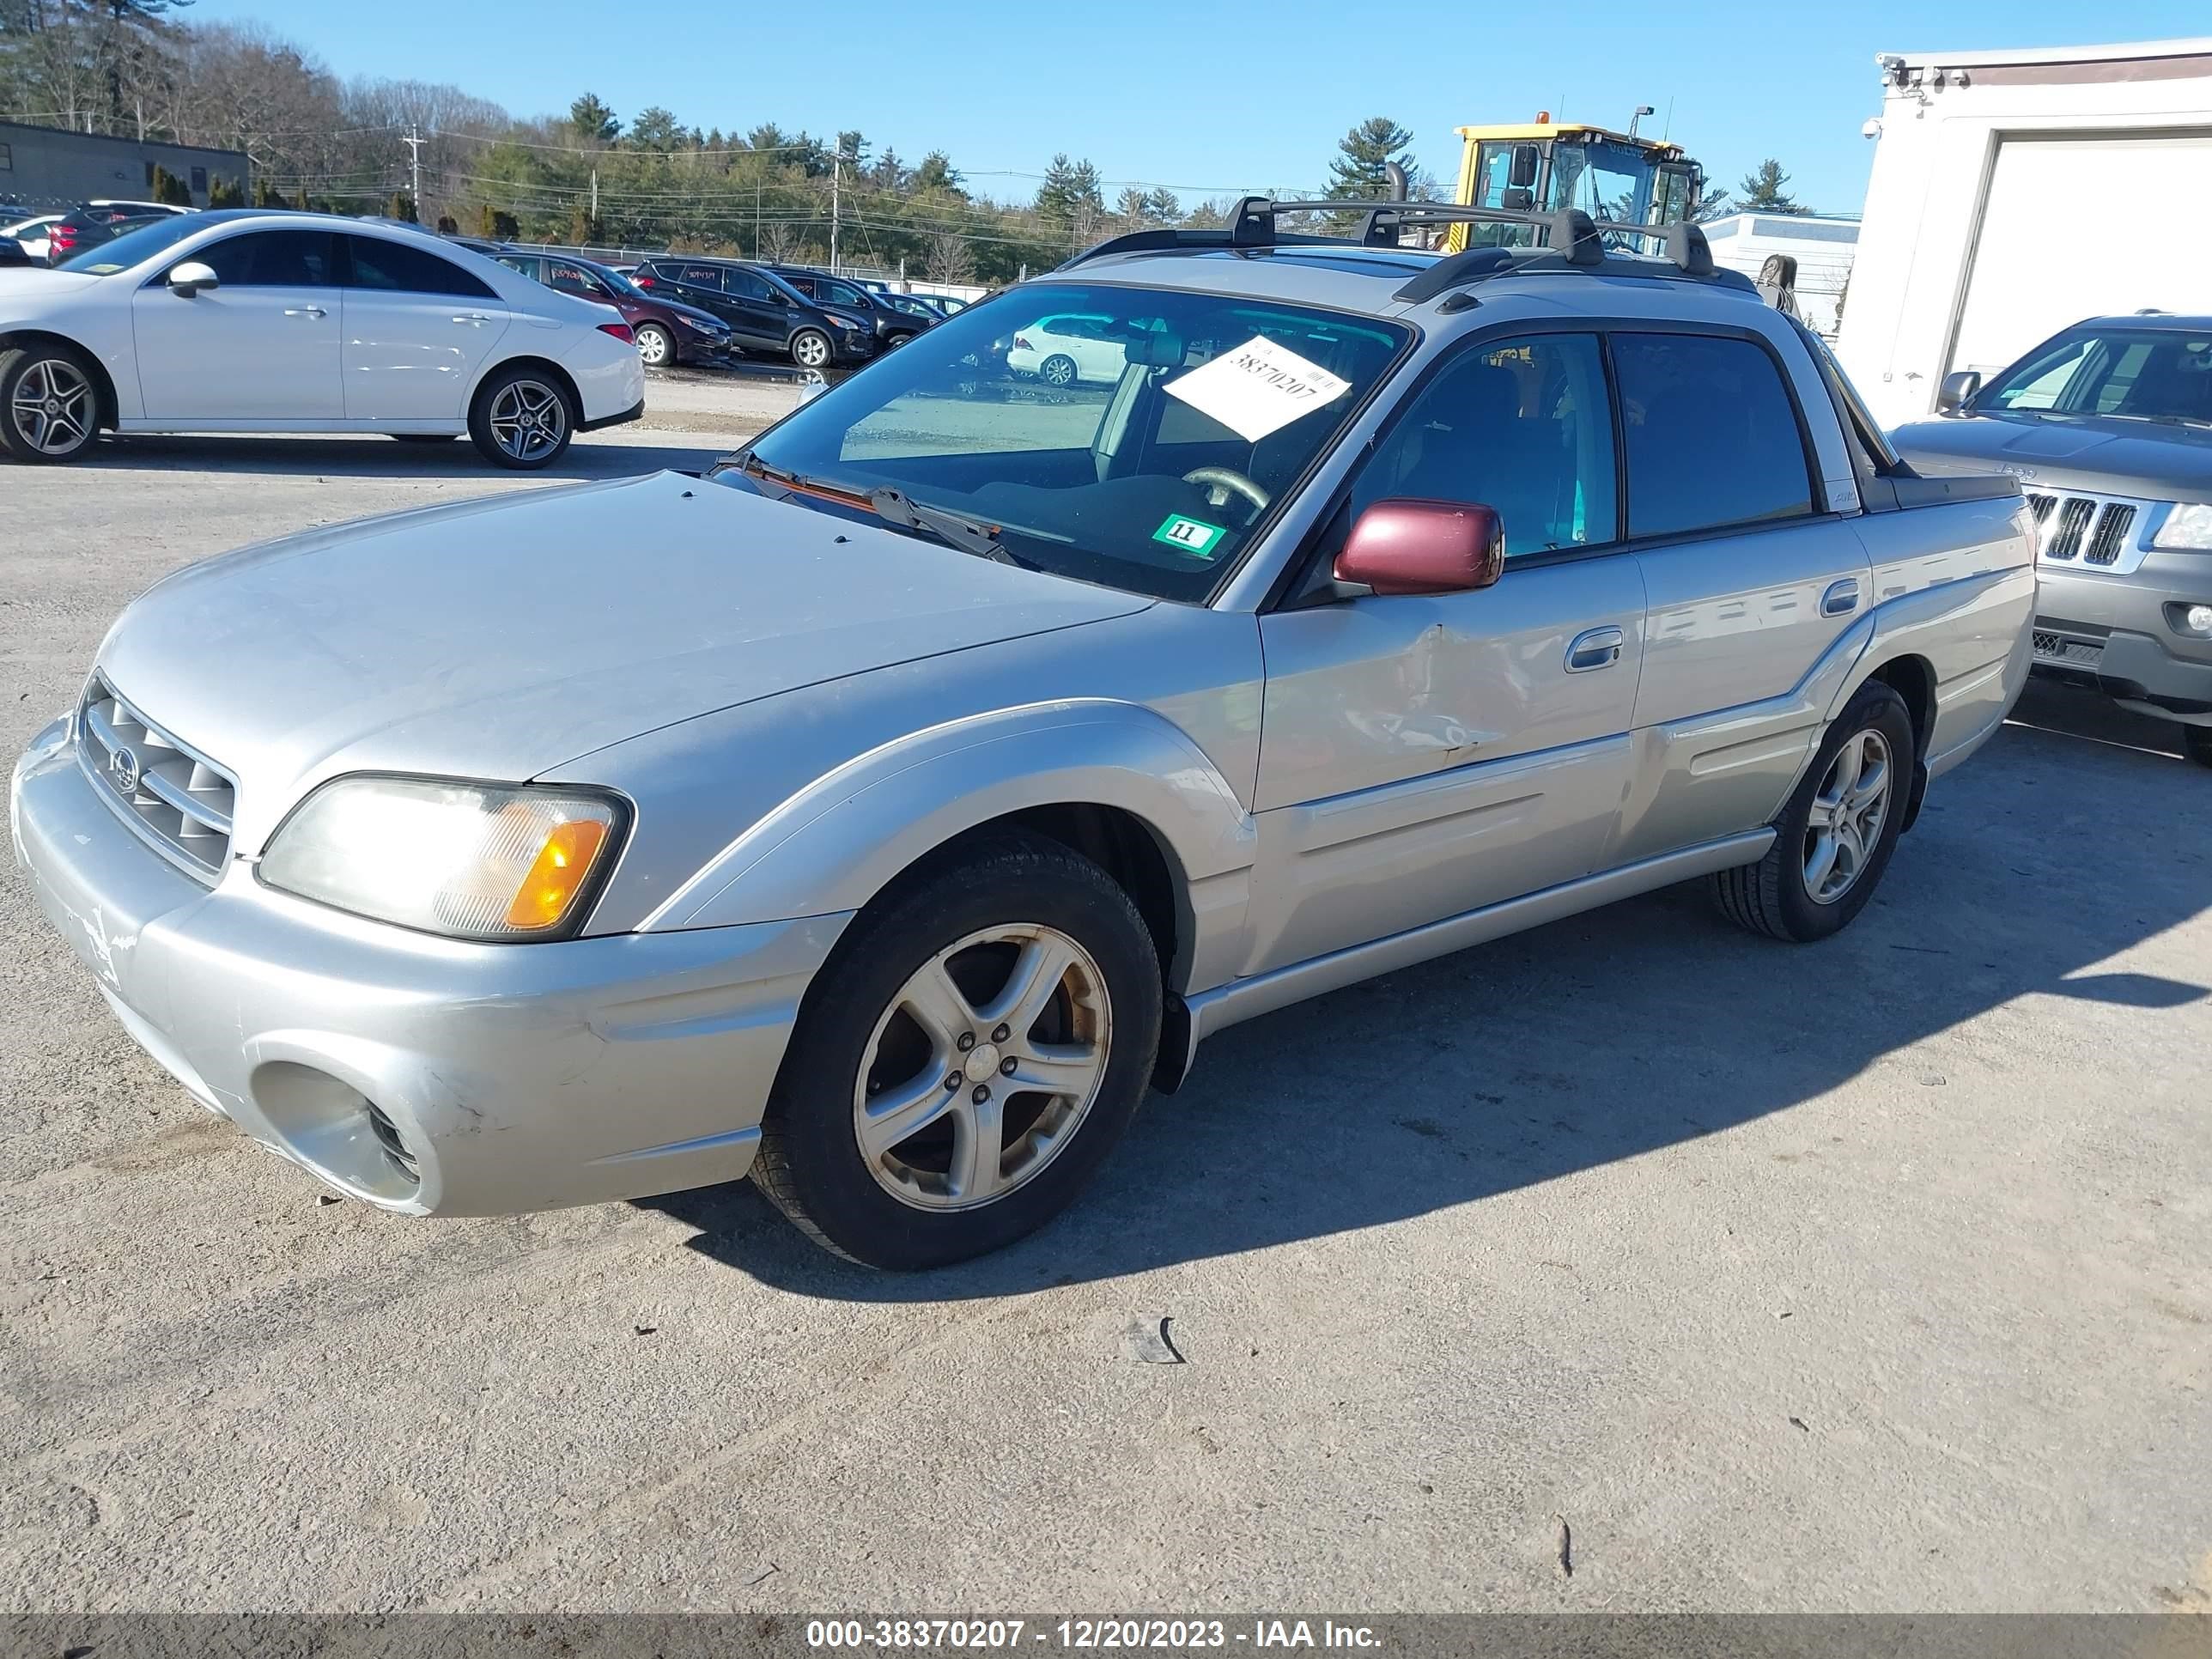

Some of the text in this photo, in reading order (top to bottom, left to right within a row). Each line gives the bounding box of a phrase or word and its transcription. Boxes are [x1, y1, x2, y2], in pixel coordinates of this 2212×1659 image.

[1608, 143, 1645, 159] VOLVO
[1230, 353, 1318, 398] 38370207
[1995, 464, 2037, 481] Jeep
[1169, 523, 1195, 542] 11
